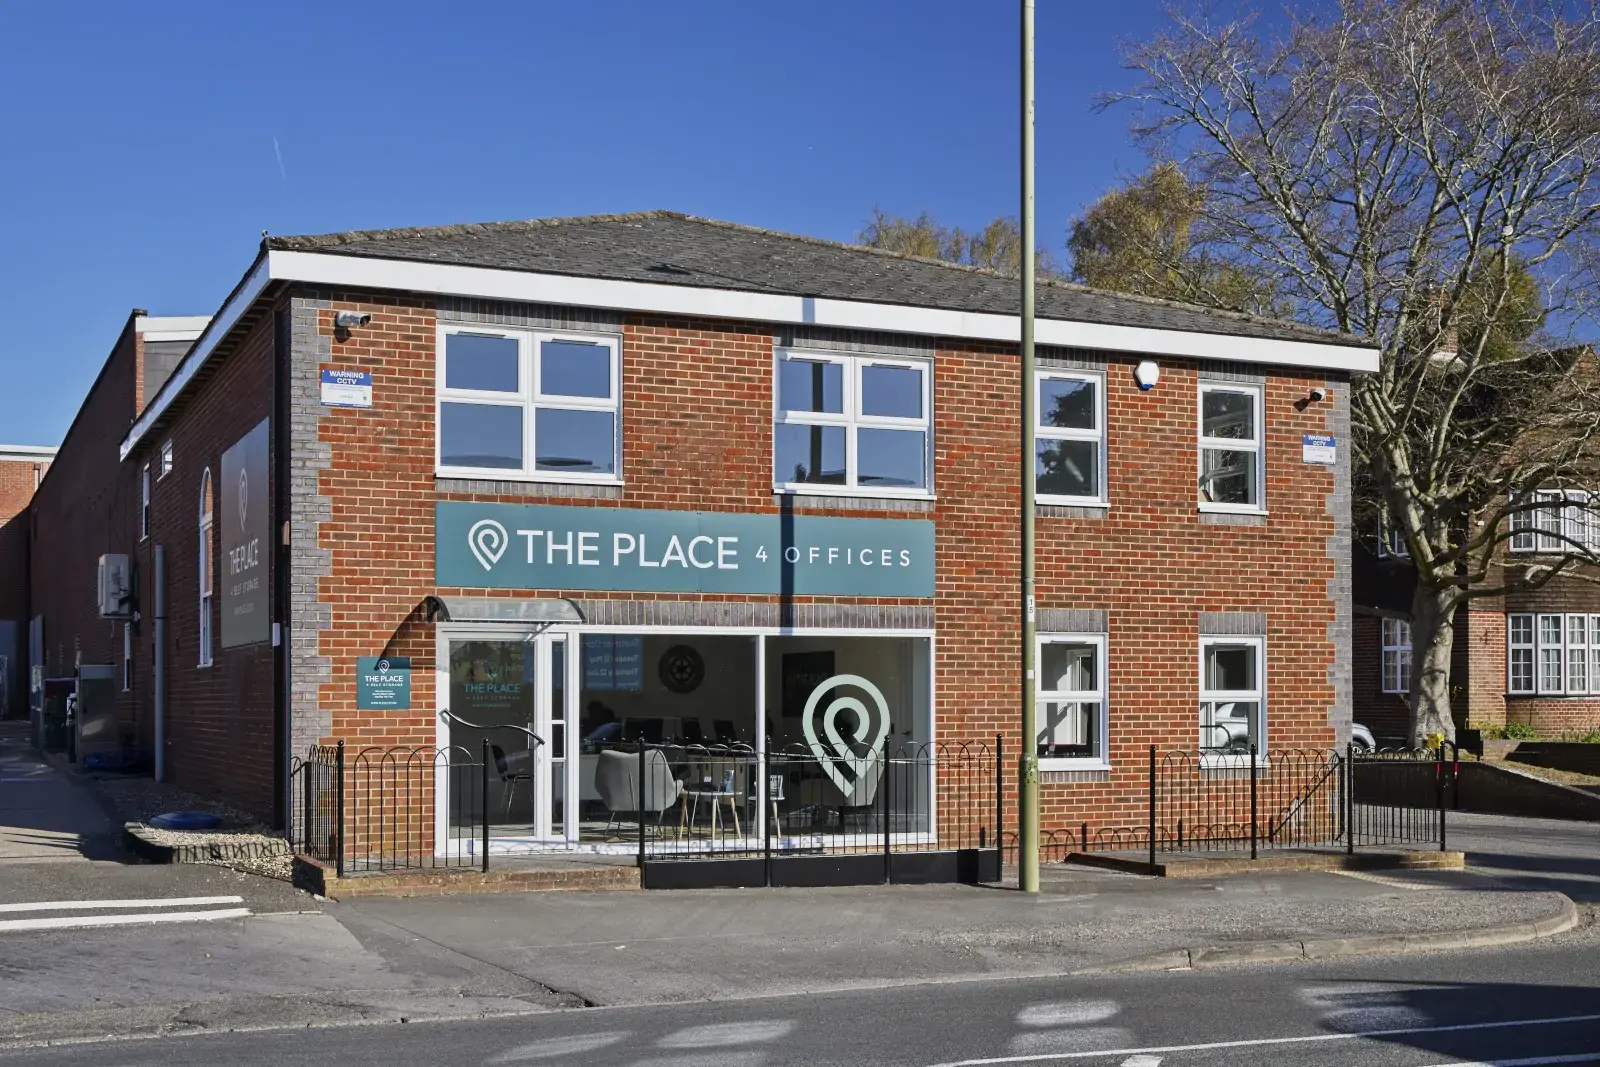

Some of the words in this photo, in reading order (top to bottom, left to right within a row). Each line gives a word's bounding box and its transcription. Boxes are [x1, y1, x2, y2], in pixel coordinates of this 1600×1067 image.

[329, 370, 364, 379] WARNING
[336, 377, 357, 385] CCTV
[516, 529, 600, 565] THE
[613, 532, 739, 570] PLACE
[755, 545, 768, 563] 4
[784, 546, 911, 566] OFFICES
[229, 547, 240, 575] THE
[240, 537, 259, 572] PLACE
[463, 683, 485, 693] THE
[487, 683, 520, 693] PLACE
